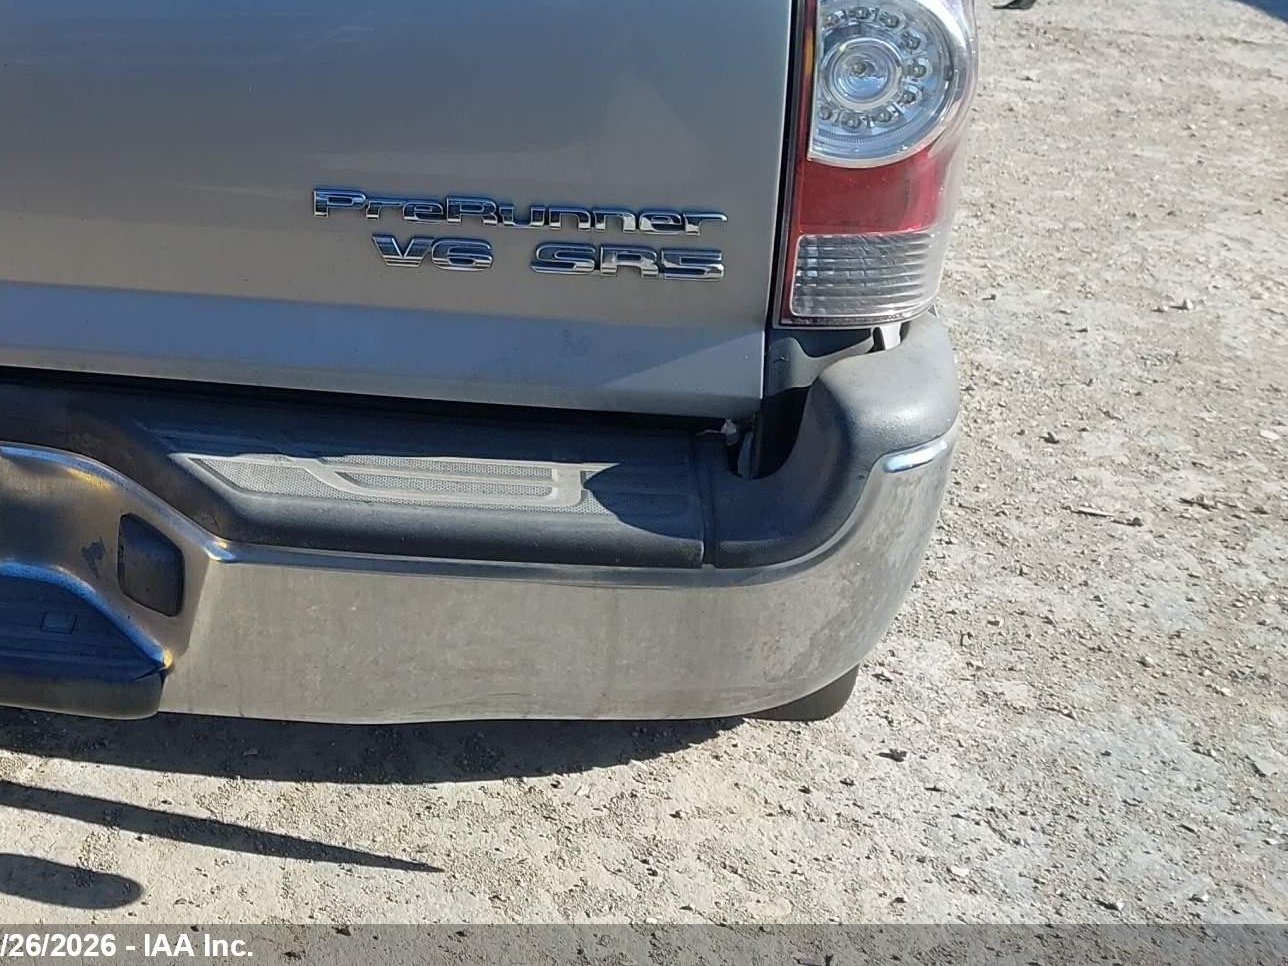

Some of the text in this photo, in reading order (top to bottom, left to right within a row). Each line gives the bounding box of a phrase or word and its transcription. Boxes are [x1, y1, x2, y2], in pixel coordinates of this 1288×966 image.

[313, 188, 728, 236] PreRunner
[372, 234, 727, 282] V6 SR5
